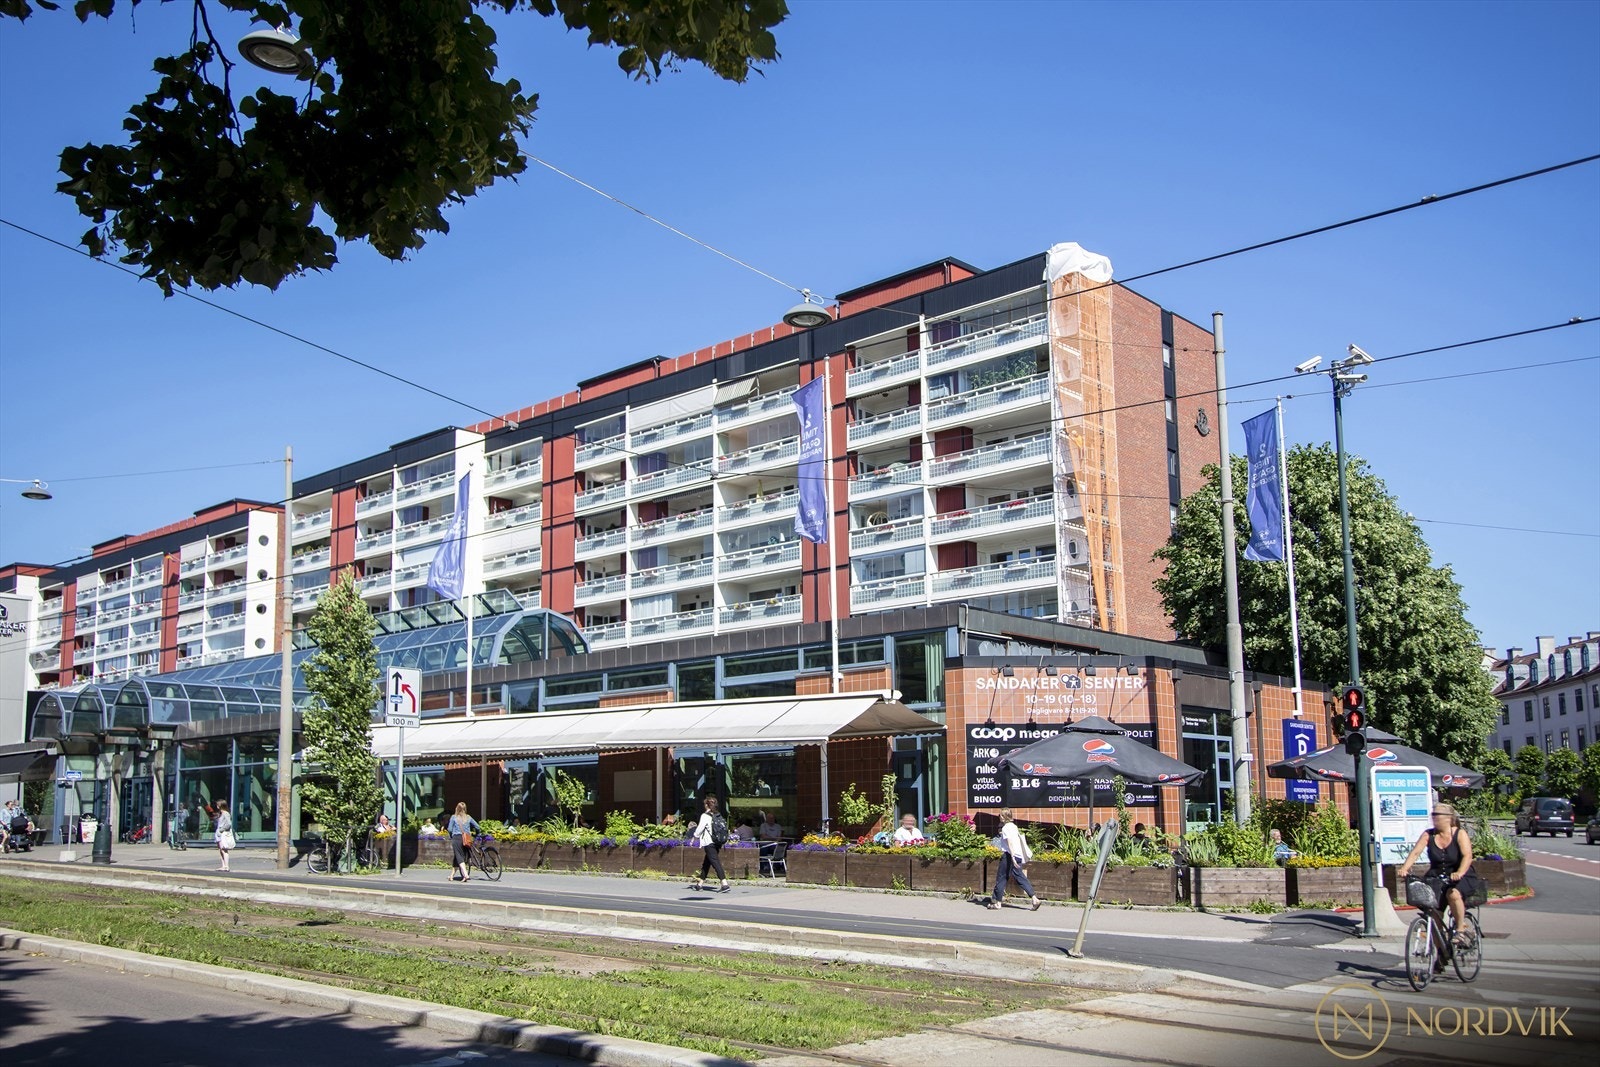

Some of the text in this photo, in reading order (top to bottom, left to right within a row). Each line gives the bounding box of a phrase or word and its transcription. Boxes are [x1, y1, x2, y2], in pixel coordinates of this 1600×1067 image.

[976, 676, 1143, 690] SANDAKER SENTER
[1026, 707, 1064, 716] Dagligvare
[392, 718, 406, 726] 100
[971, 727, 1016, 741] coop
[1011, 778, 1040, 788] BLG
[974, 795, 1002, 803] BINGO
